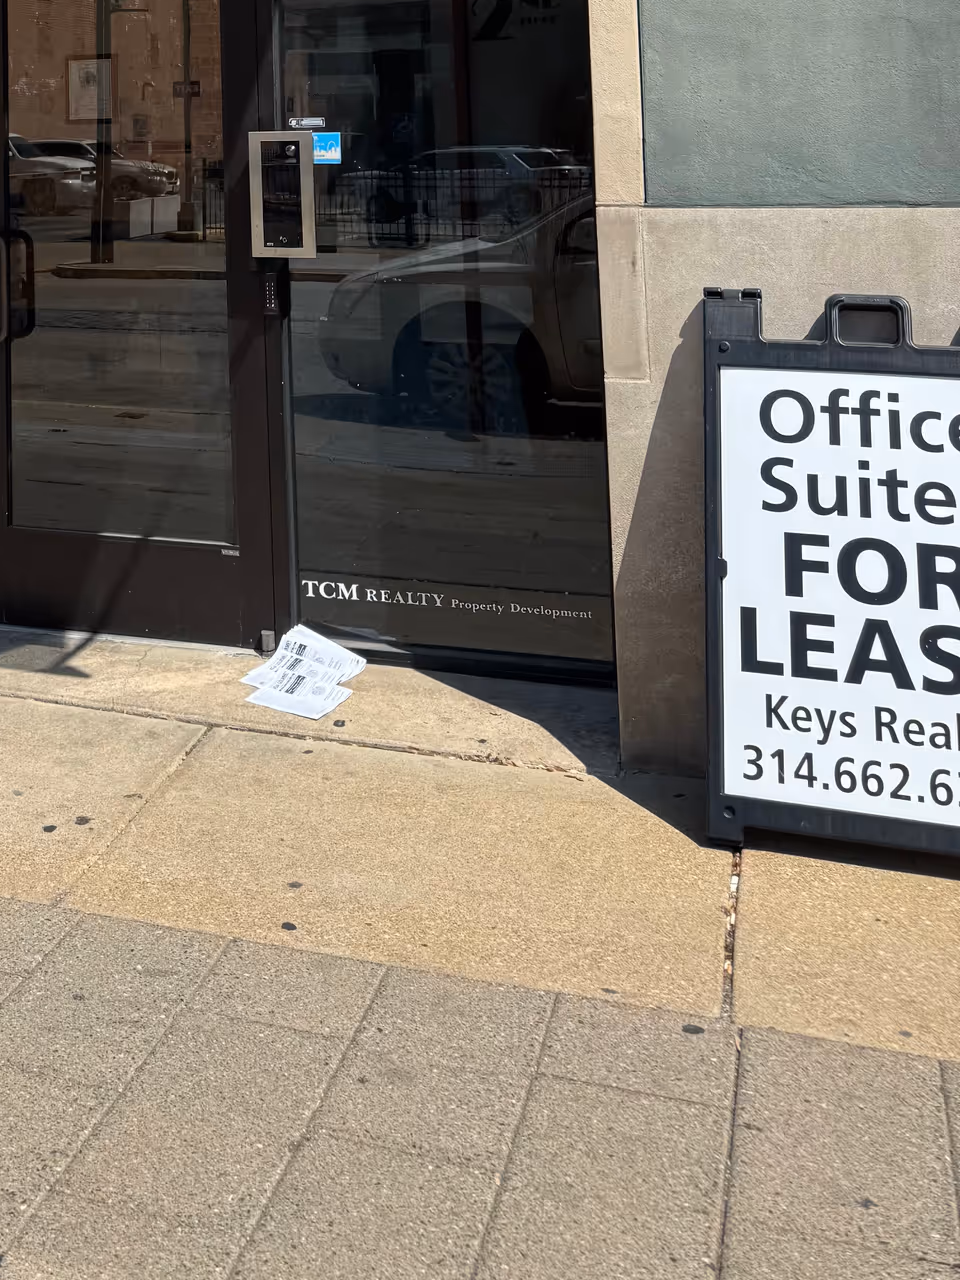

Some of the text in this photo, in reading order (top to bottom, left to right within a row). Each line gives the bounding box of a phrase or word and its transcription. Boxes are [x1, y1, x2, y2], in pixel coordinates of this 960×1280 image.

[759, 388, 960, 453] Offic
[760, 456, 957, 525] Suite
[302, 580, 593, 619] TCM REALTY Property Development
[784, 532, 960, 611] FOR
[740, 606, 960, 696] LEAS
[765, 693, 857, 745] Keys
[743, 744, 960, 807] 314.662.6
